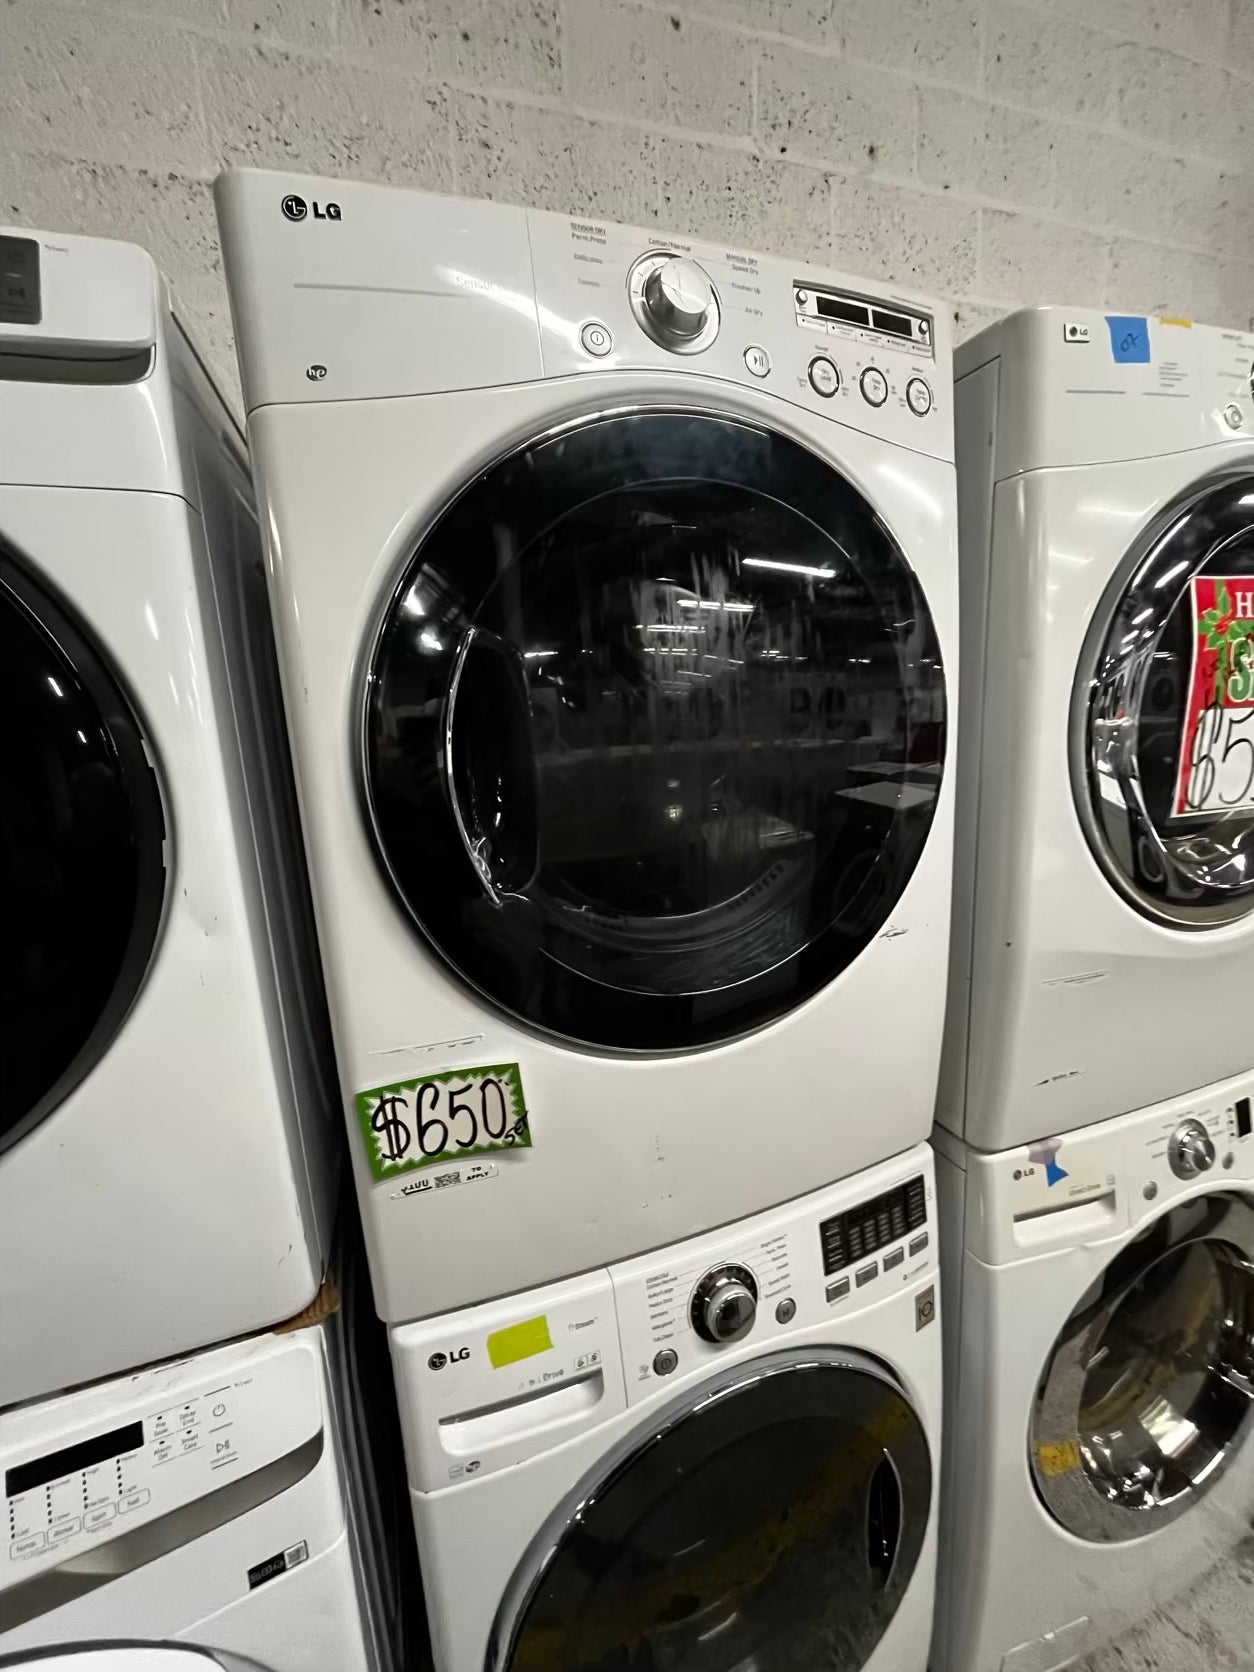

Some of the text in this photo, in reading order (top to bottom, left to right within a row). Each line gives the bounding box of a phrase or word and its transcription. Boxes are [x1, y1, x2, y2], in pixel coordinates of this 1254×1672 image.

[313, 201, 342, 221] LG
[371, 1078, 506, 1161] $650
[466, 1171, 489, 1181] APPLY
[1023, 1167, 1035, 1177] LG
[449, 1347, 470, 1363] LG
